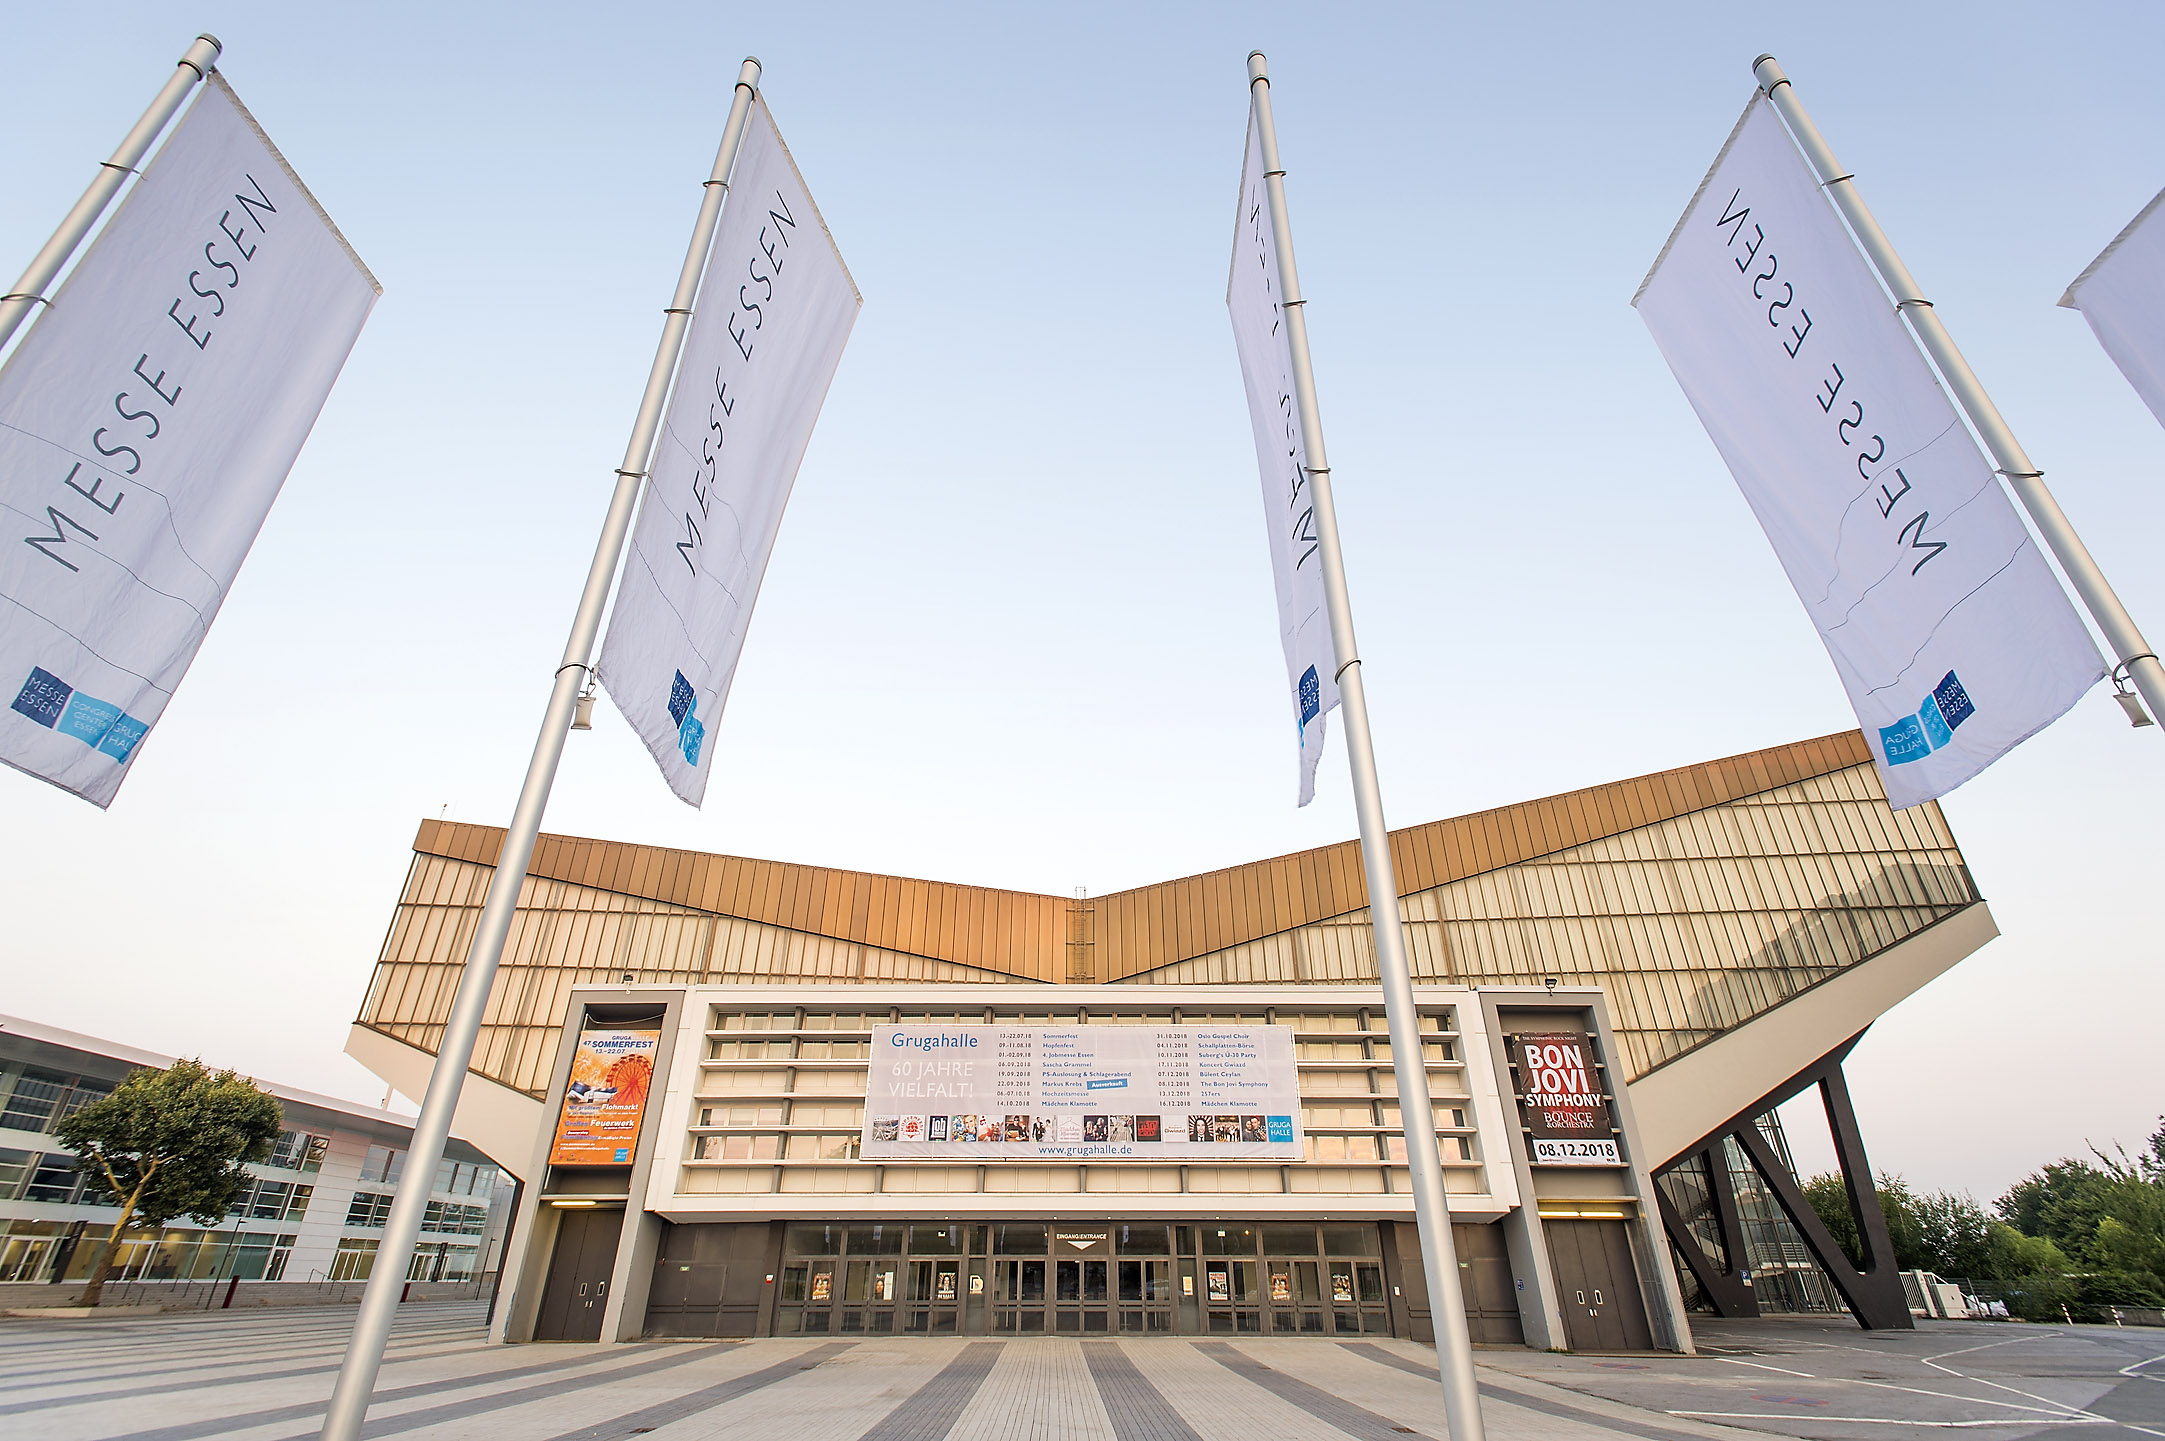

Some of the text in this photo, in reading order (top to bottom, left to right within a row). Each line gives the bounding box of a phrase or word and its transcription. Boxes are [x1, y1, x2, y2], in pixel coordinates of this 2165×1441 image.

[24, 174, 277, 572] MESSE ESSEN
[676, 190, 796, 577] MESSE ESSEN
[28, 677, 66, 705] MESSE
[20, 690, 59, 718] ESSEN
[113, 723, 142, 742] GRUG
[107, 736, 130, 751] HAL
[891, 1033, 978, 1051] Grugahalle
[1524, 1045, 1584, 1069] BON
[892, 1061, 973, 1080] 60 JAHRE
[1091, 1080, 1124, 1088] Ausverkauft
[1530, 1068, 1590, 1093] JOVI
[888, 1082, 973, 1098] VIELFALT!
[1526, 1093, 1601, 1107] SYMPHONY
[590, 1119, 635, 1127] Feuerwerk
[1543, 1112, 1593, 1122] BOUNCE
[1039, 1145, 1132, 1156] www.grugahalle.de
[1538, 1144, 1615, 1156] 08.12.2018
